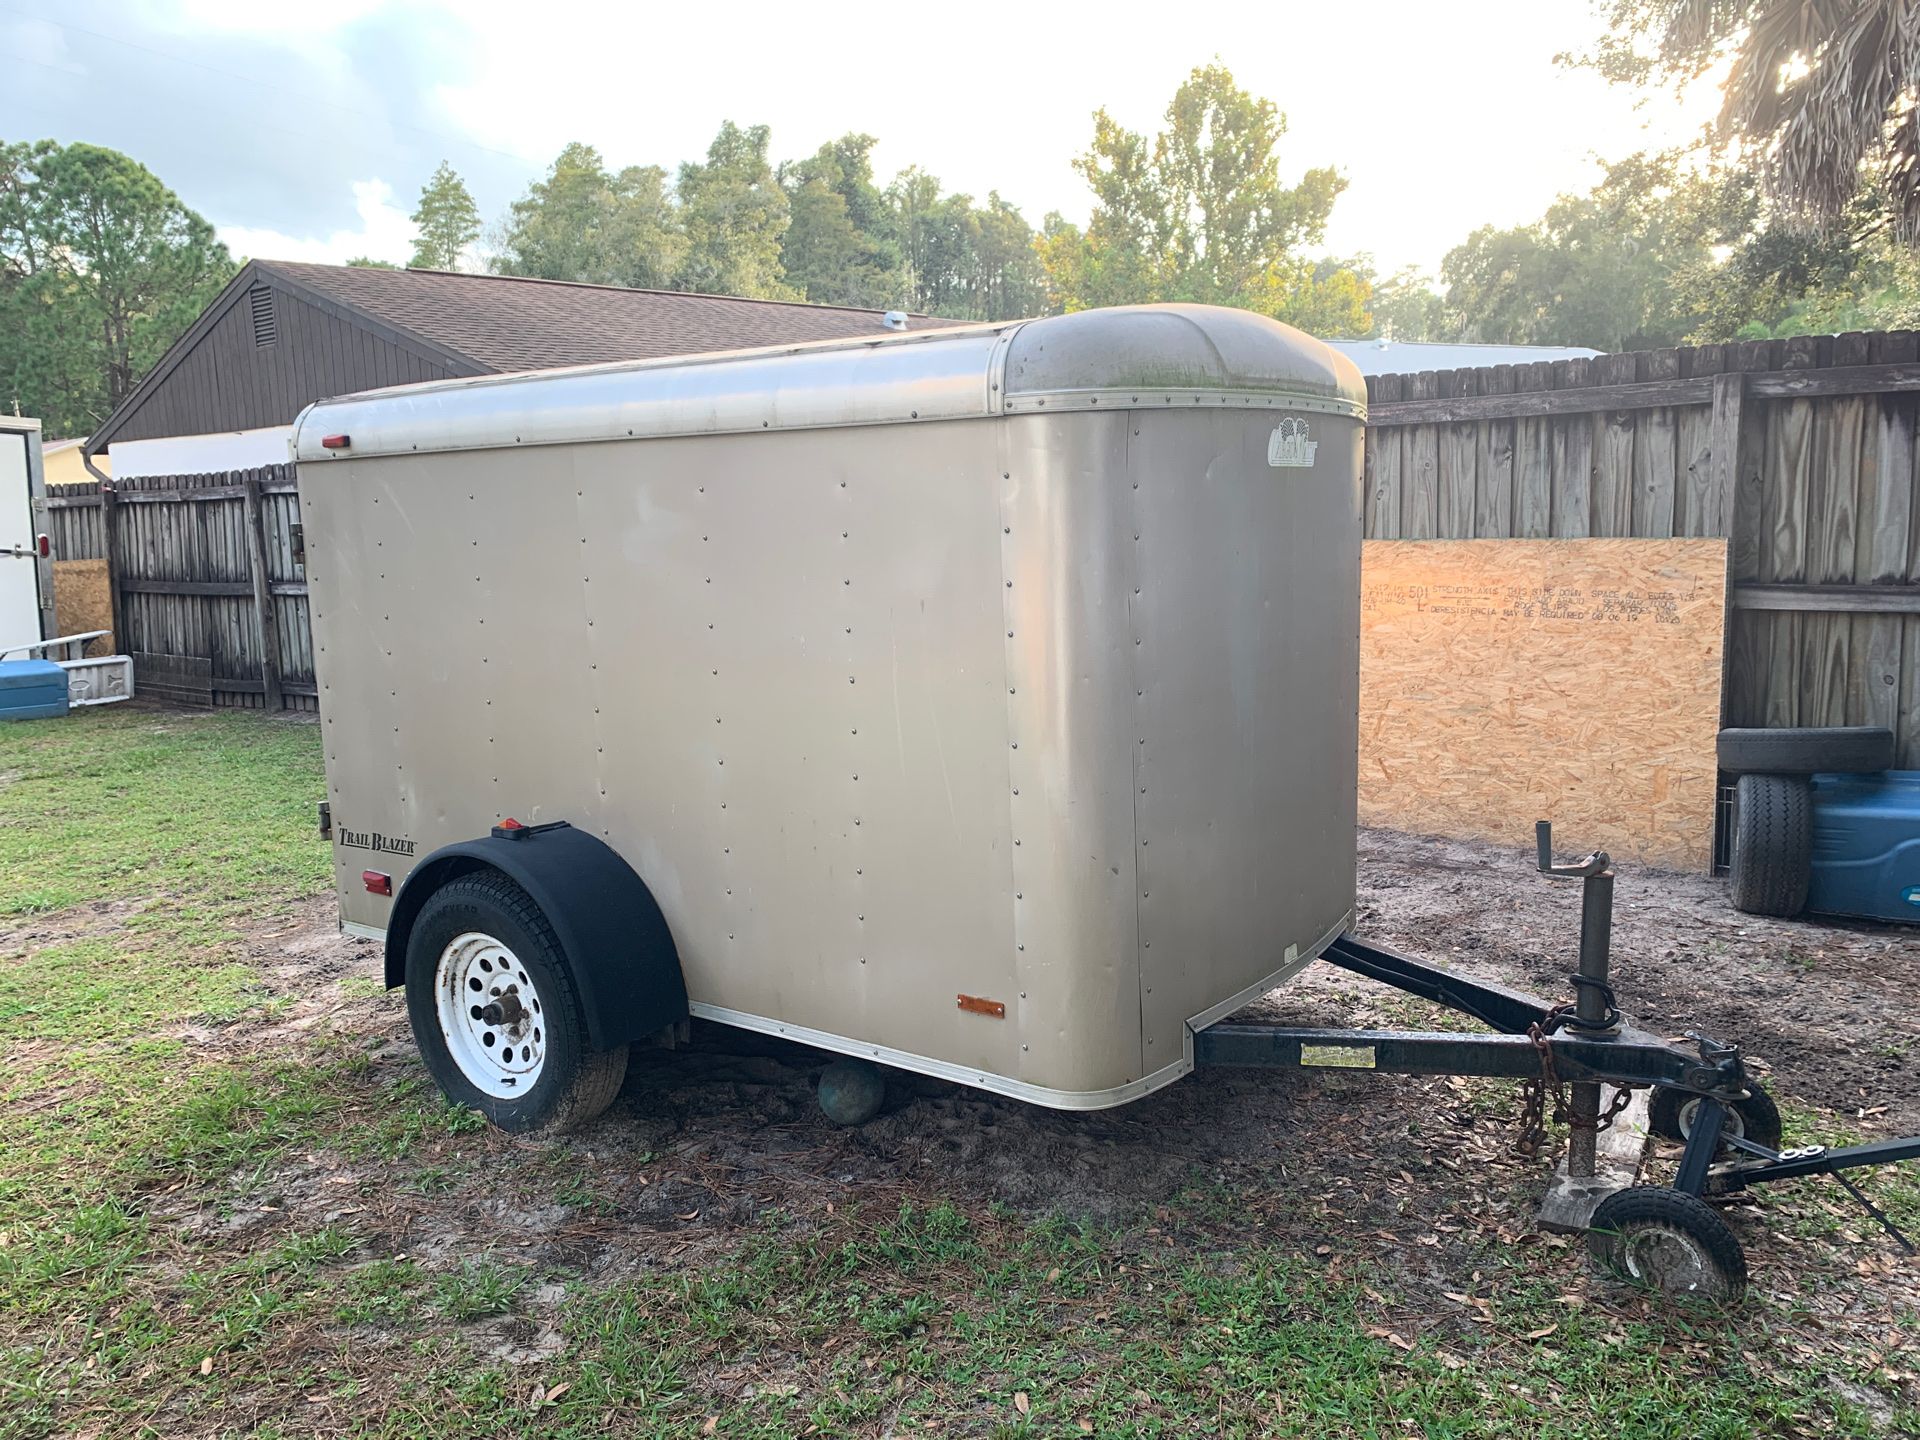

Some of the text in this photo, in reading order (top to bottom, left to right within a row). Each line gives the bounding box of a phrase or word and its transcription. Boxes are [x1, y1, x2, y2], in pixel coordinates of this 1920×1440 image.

[1508, 586, 1528, 595] THIS
[1591, 590, 1620, 598] SPACE
[1524, 609, 1534, 618] BE
[1540, 610, 1584, 619] REQUIRED
[339, 827, 414, 853] TRAIL BLAZER
